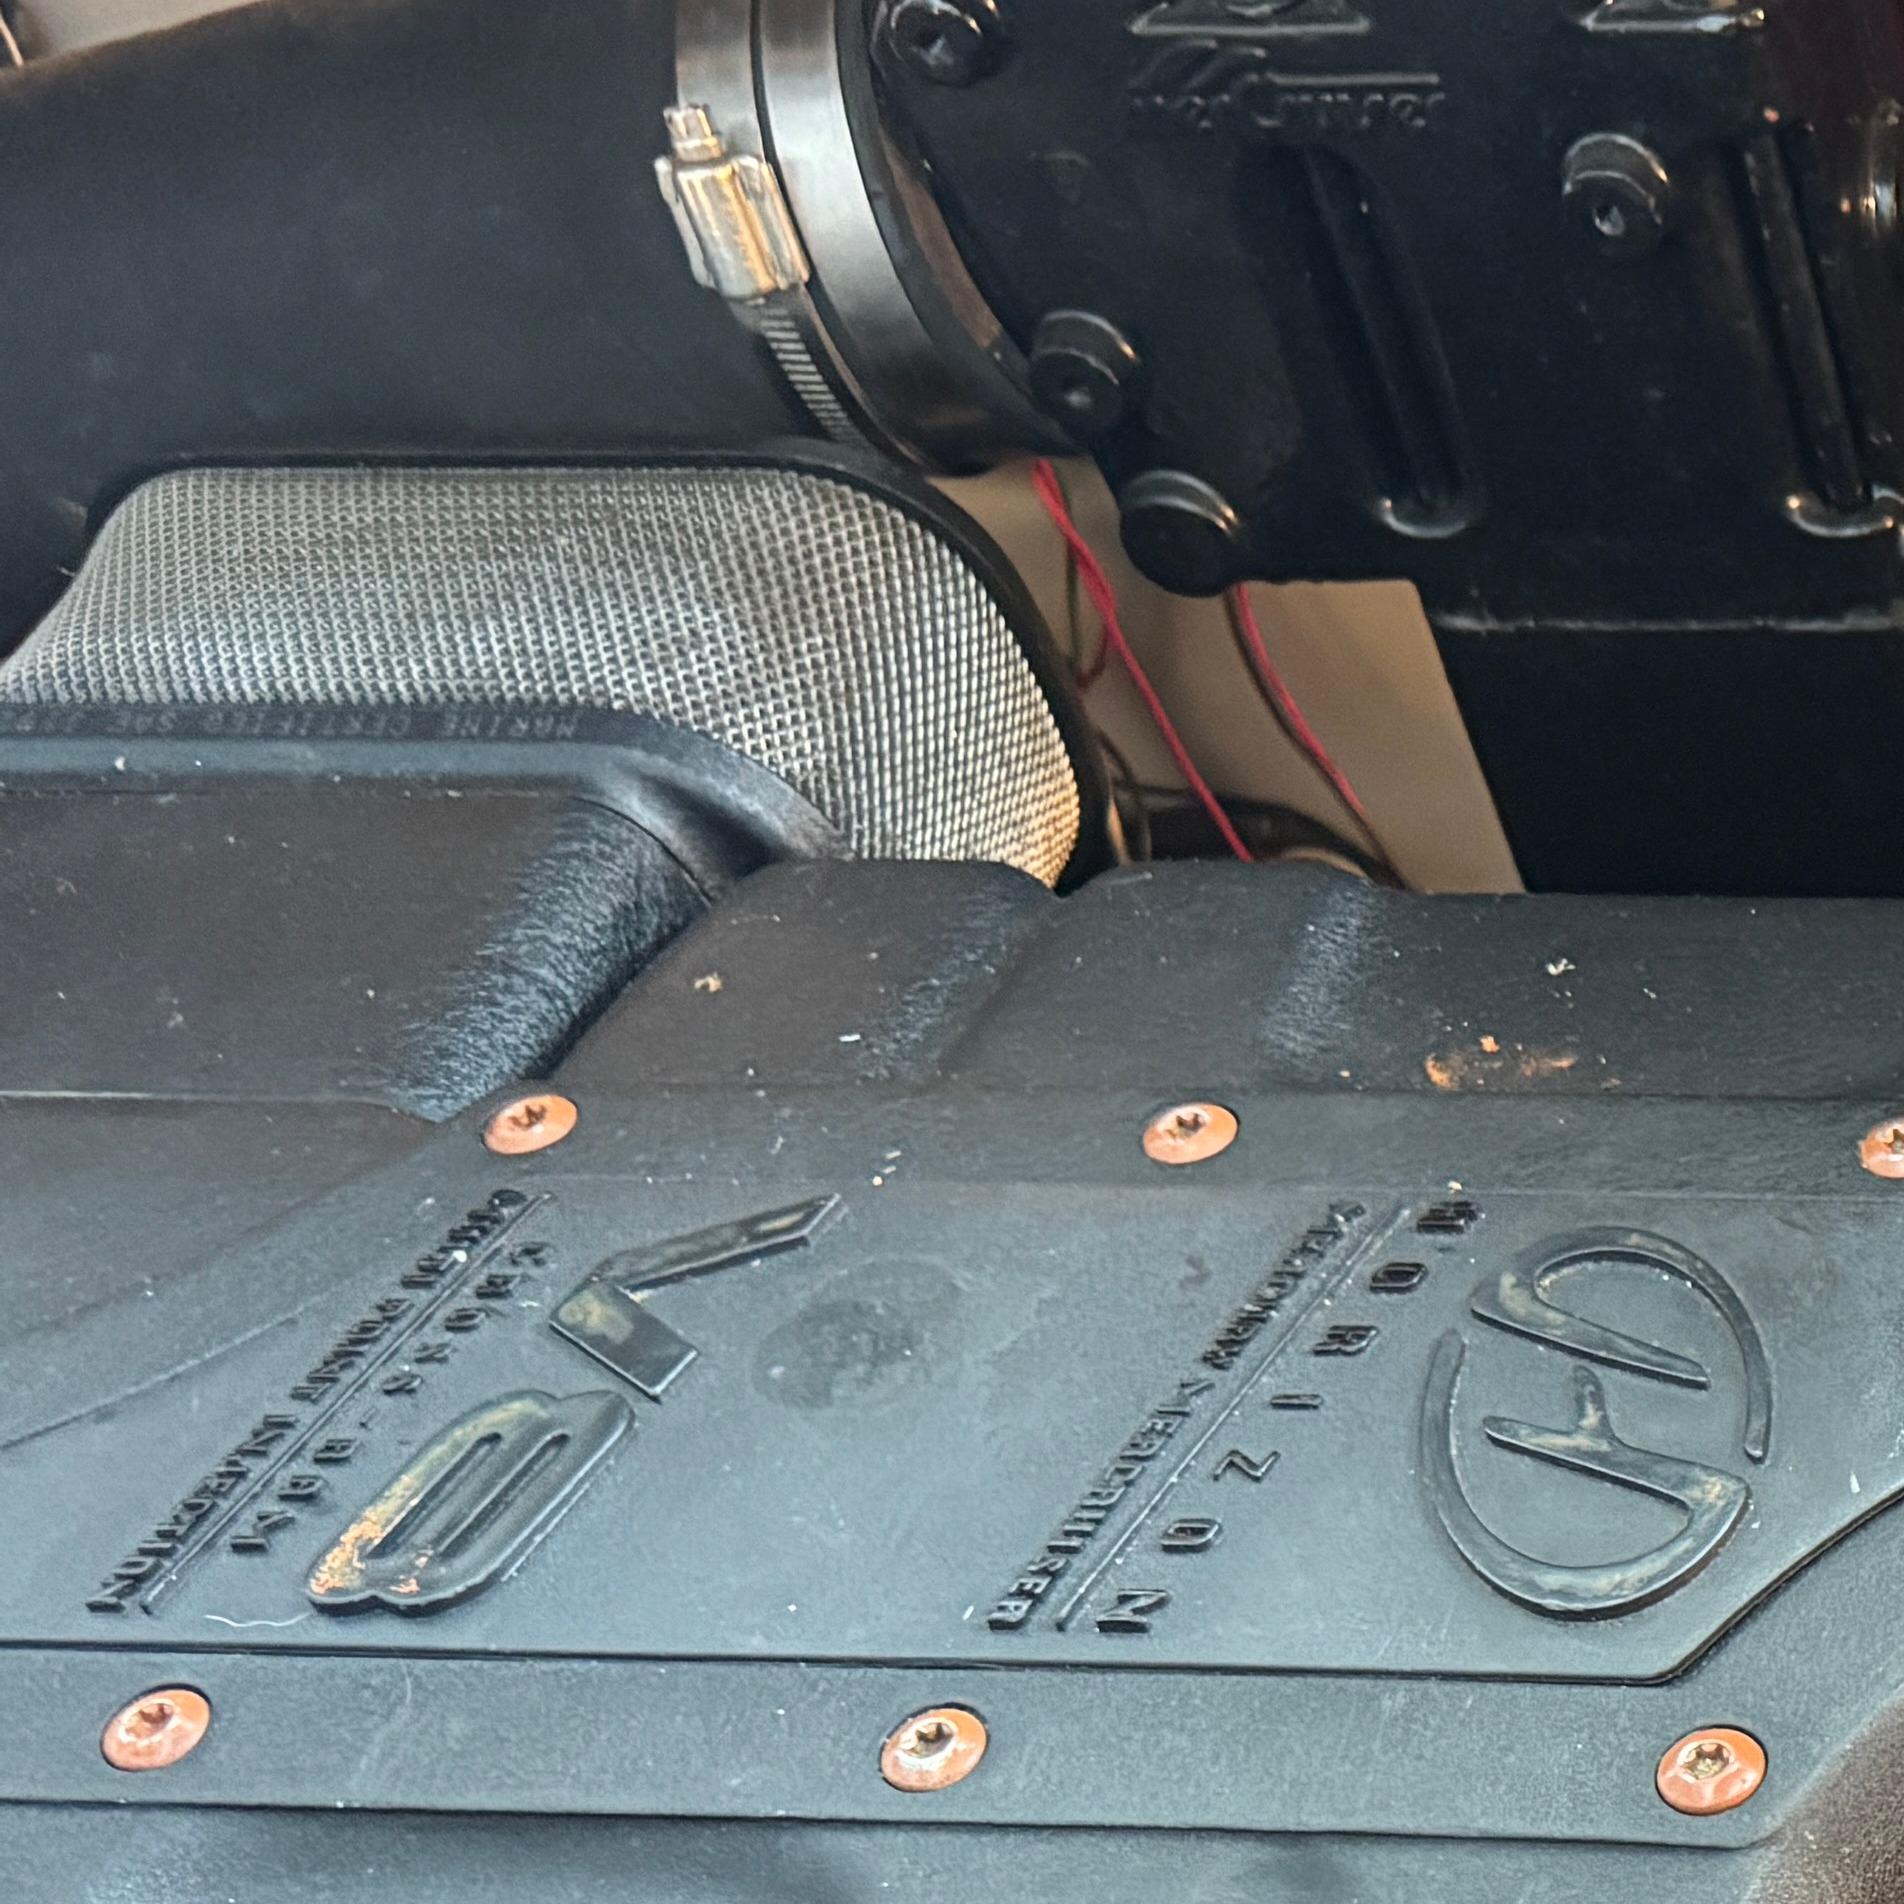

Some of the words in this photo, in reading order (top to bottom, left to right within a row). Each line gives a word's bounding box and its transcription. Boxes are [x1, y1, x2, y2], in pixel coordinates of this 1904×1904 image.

[85, 1412, 299, 1612] INJECTION
[987, 1379, 1213, 1630] MERCRUISER
[1095, 1198, 1485, 1633] HORIZON
